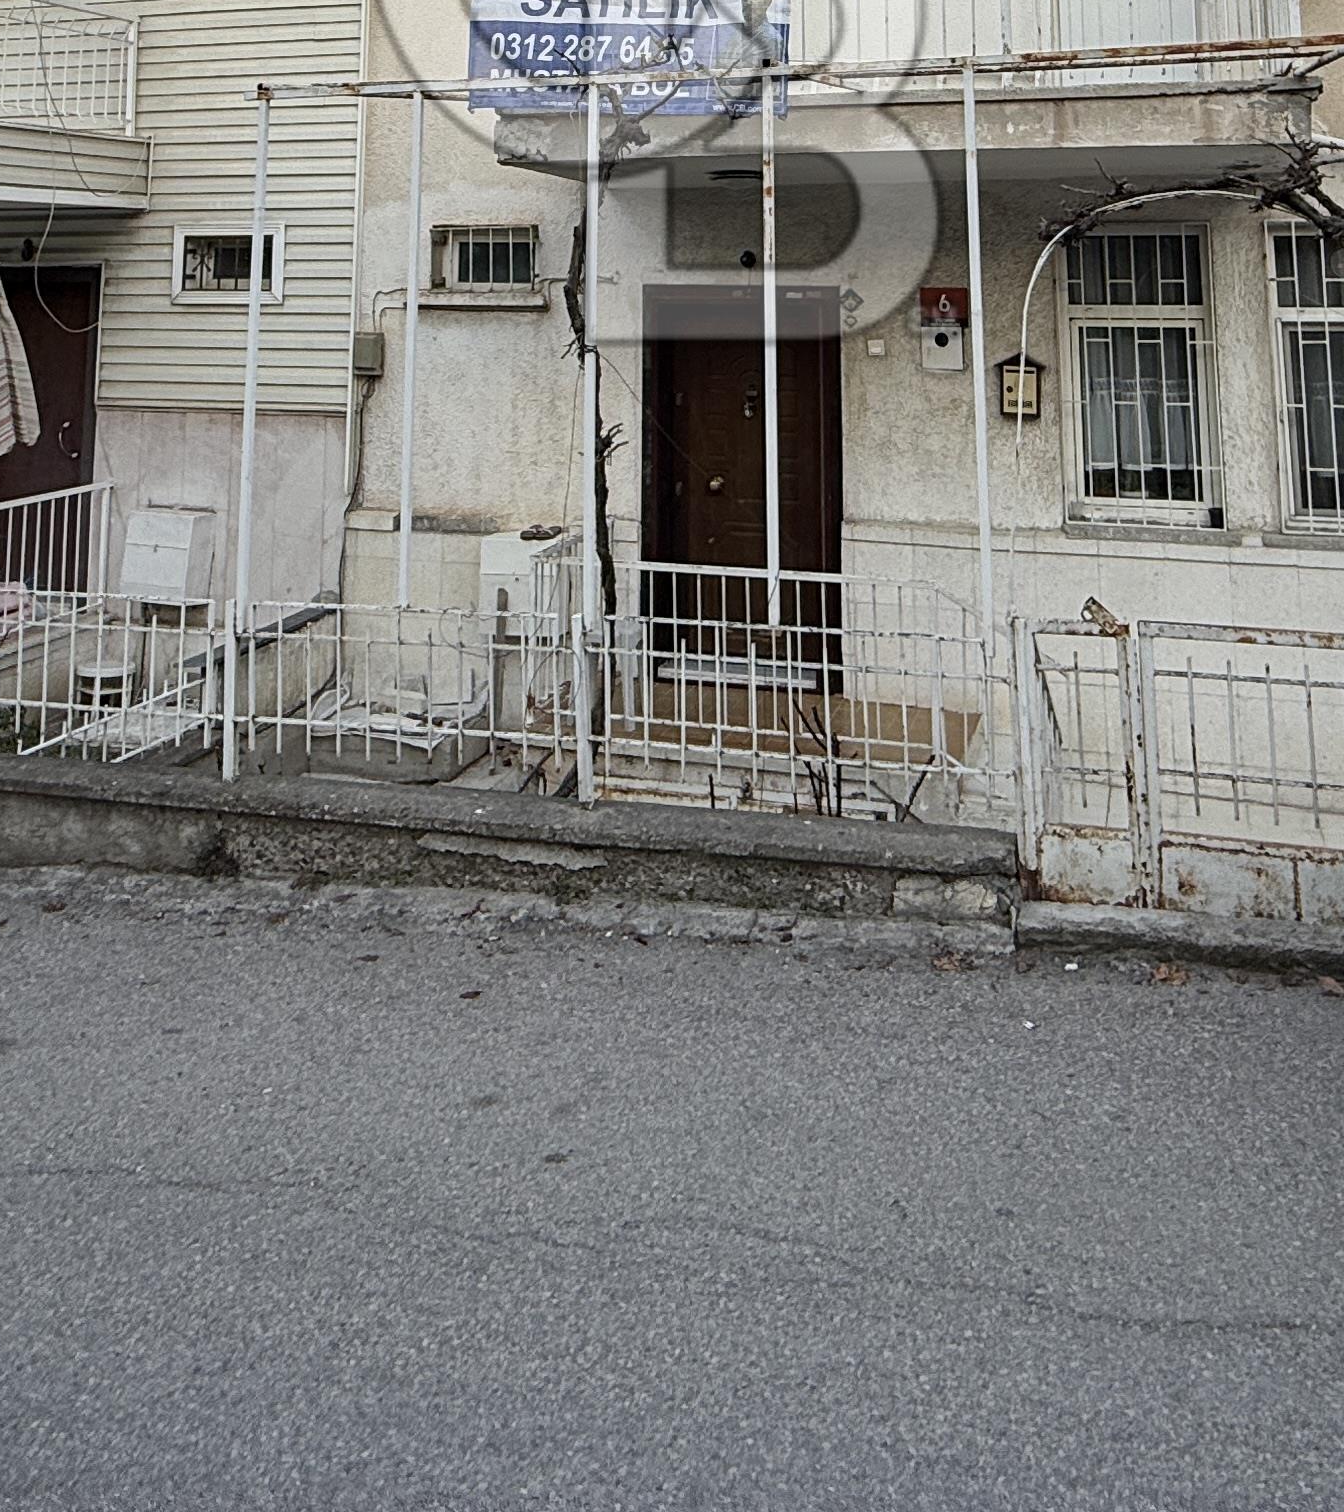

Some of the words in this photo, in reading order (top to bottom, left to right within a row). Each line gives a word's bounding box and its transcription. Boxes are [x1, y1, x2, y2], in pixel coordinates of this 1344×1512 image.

[490, 32, 556, 61] 0312
[561, 34, 613, 62] 287
[619, 35, 652, 63] 64
[938, 293, 951, 313] 6
